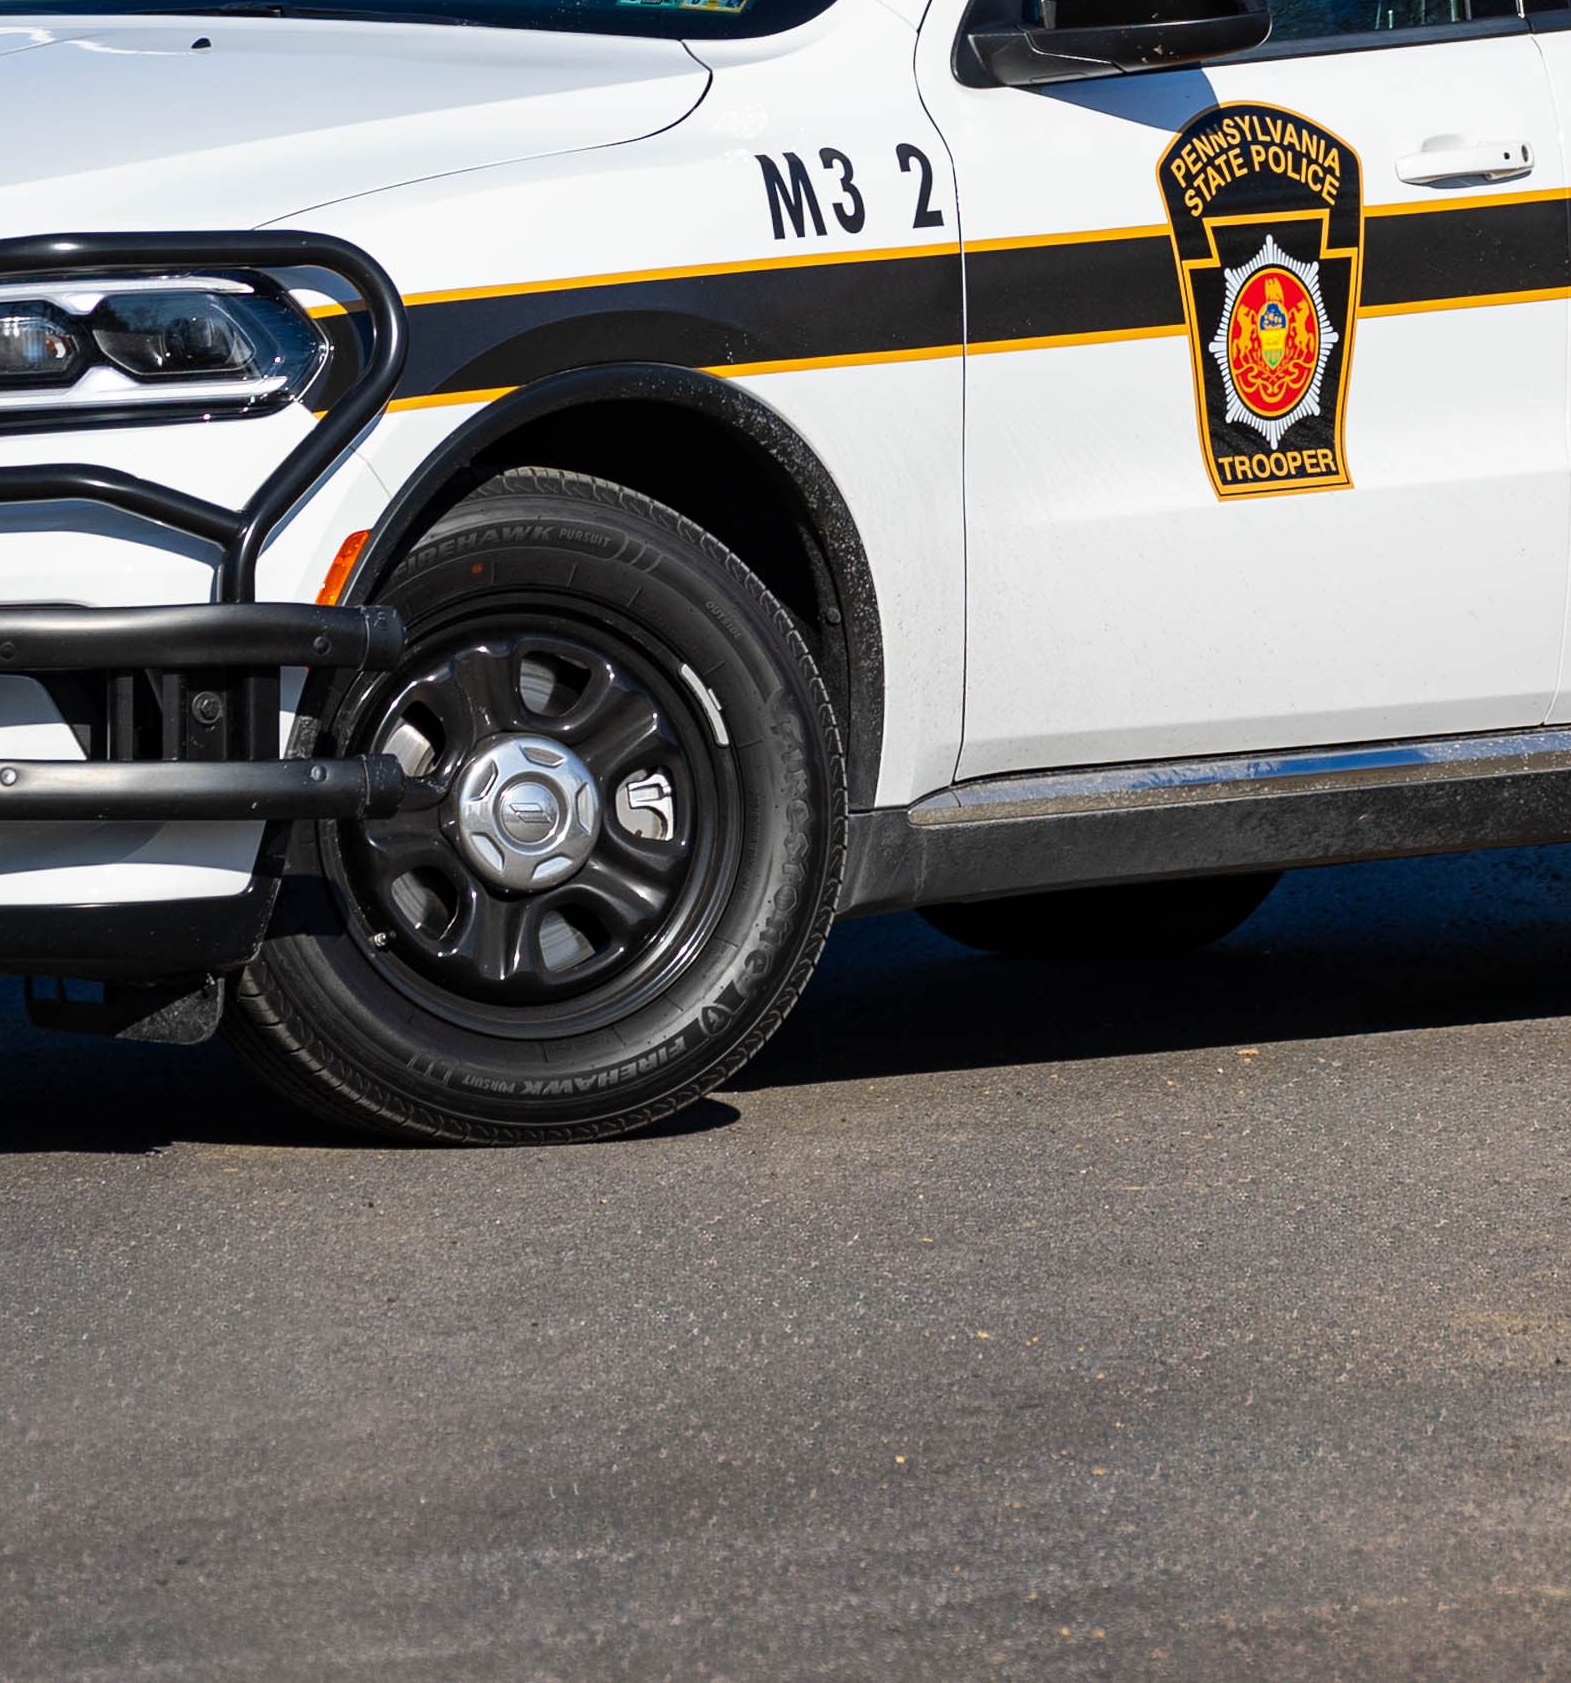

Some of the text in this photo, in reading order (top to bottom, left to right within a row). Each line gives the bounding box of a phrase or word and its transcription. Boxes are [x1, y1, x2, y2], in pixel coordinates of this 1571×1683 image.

[1170, 115, 1340, 188] PENNSYLVANIA
[895, 143, 944, 229] 2
[1184, 145, 1340, 217] STATE POLICE
[1218, 448, 1337, 481] TROOPER
[558, 527, 612, 548] PURSUIT
[462, 1073, 516, 1092] PURSUIT
[522, 1036, 687, 1094] FIREHAWK
